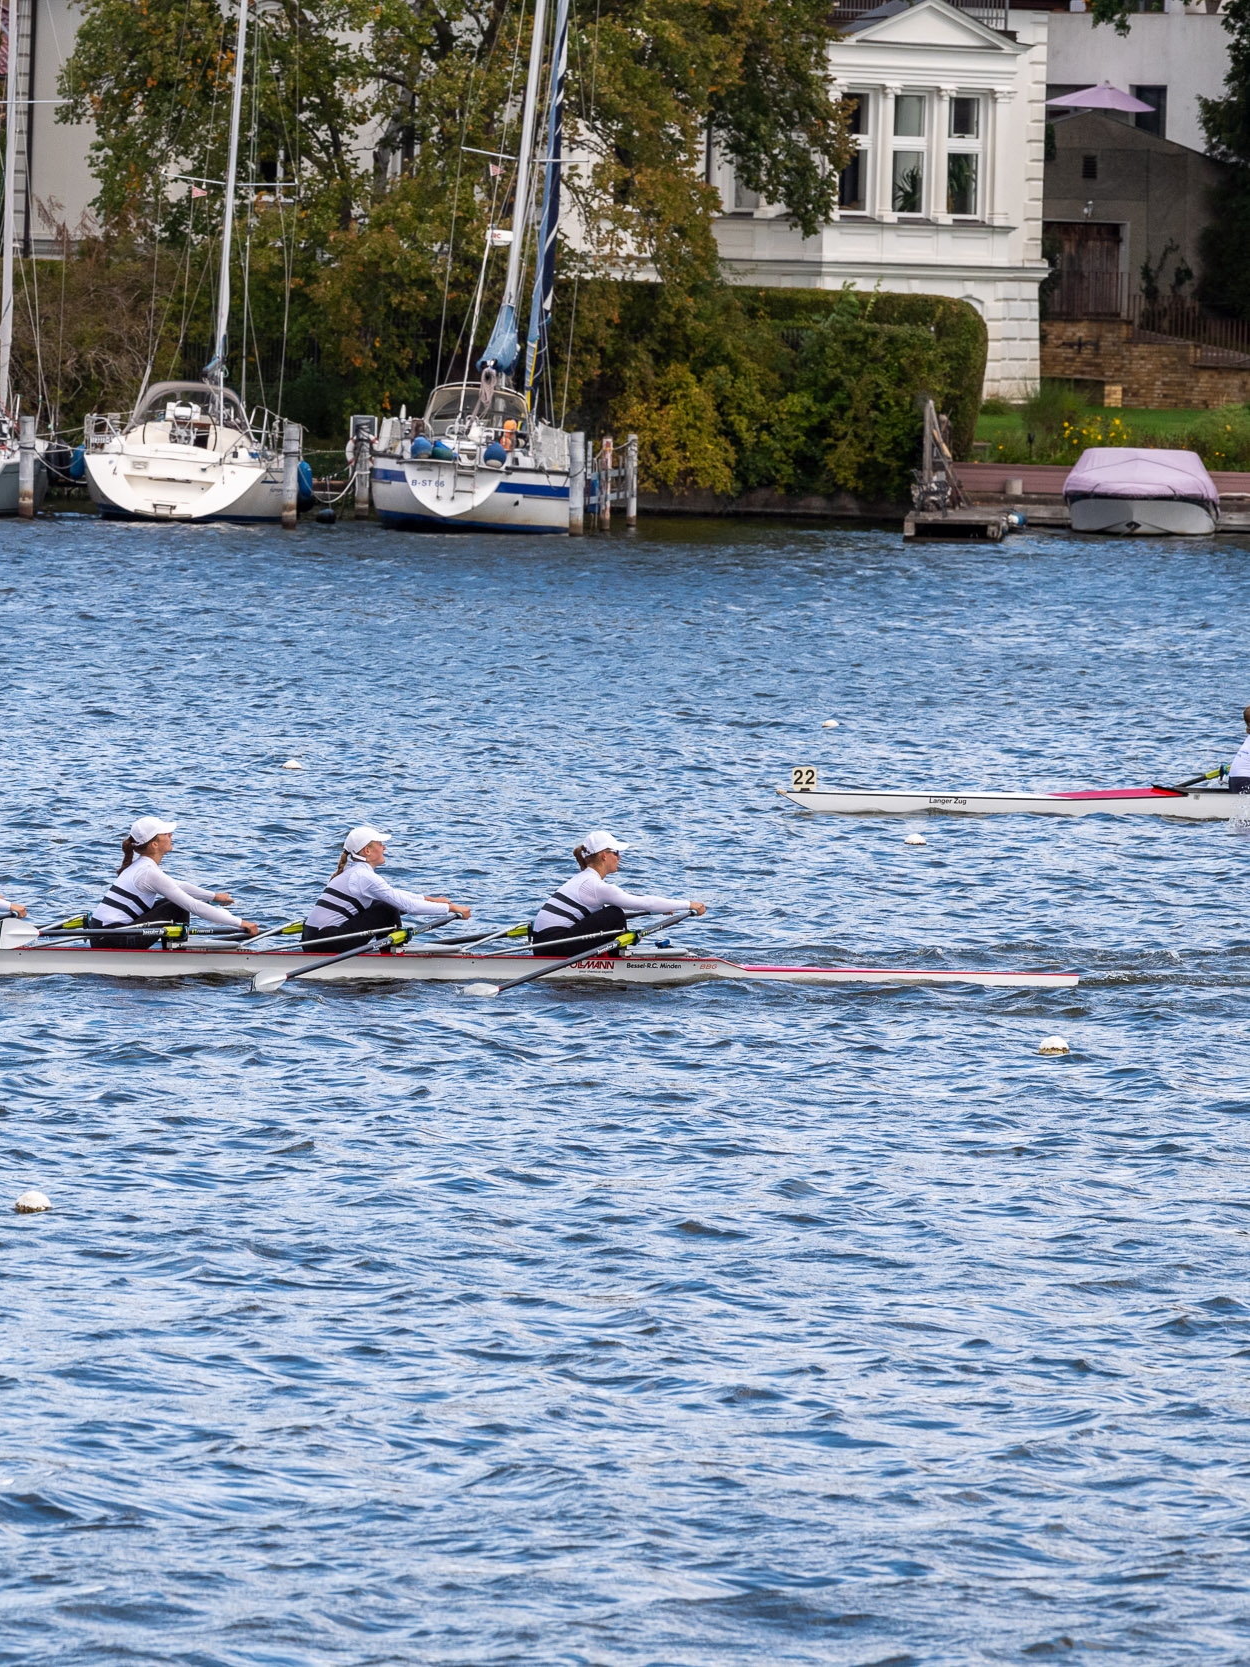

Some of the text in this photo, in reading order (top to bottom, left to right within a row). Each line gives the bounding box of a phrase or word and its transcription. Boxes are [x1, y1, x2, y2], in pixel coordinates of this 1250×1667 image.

[411, 479, 432, 487] B-ST
[793, 769, 815, 785] 22
[929, 797, 967, 806] Langer Zug
[564, 960, 615, 970] OLLMANN
